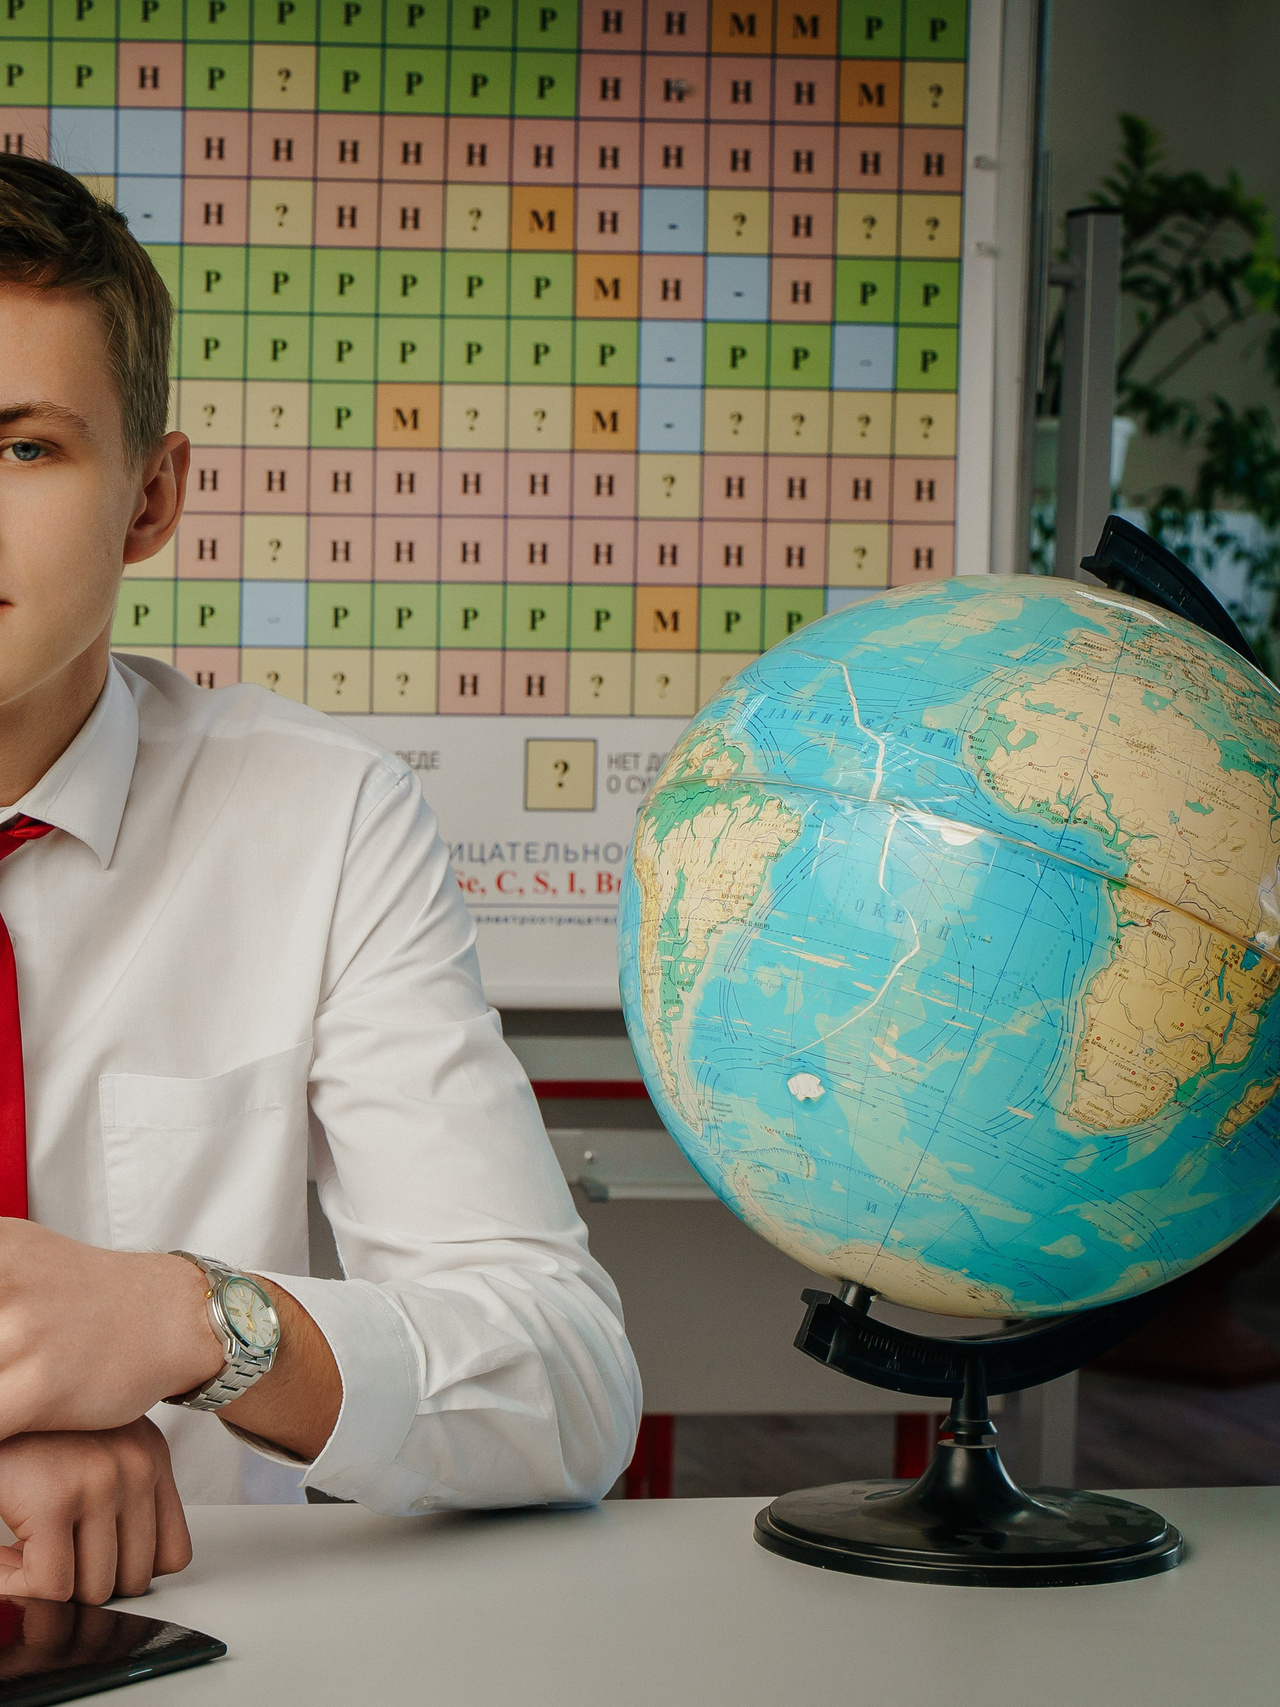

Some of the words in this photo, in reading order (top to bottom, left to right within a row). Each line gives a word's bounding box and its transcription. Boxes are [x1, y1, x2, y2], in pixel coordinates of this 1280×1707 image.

[6, 64, 24, 87] Р
[75, 65, 93, 88] Р
[139, 66, 159, 89] Н
[207, 67, 225, 91] Р
[341, 70, 360, 94] Р
[405, 72, 423, 96] Р
[470, 73, 488, 98] Р
[537, 75, 555, 99] Р
[600, 77, 621, 100] Н
[731, 80, 752, 104] Н
[795, 81, 815, 105] Н
[860, 83, 885, 107] М
[204, 203, 224, 225] Н
[338, 206, 357, 228] Н
[401, 207, 420, 230] Н
[531, 210, 556, 232] М
[599, 211, 618, 233] Н
[793, 214, 813, 237] Н
[335, 407, 352, 429] Р
[395, 408, 419, 430] М
[594, 410, 618, 433] М
[133, 604, 150, 626] Р
[198, 605, 215, 627] Р
[332, 607, 349, 629] Р
[396, 607, 413, 629] Р
[462, 608, 479, 630] Р
[529, 609, 546, 631] Р
[593, 609, 611, 632] Р
[656, 610, 679, 632] М
[724, 611, 741, 633] Р
[785, 611, 803, 634] Р
[553, 759, 570, 788] ?
[606, 752, 641, 771] НЕТ
[447, 841, 629, 866] ИЦАТЕЛЬНО
